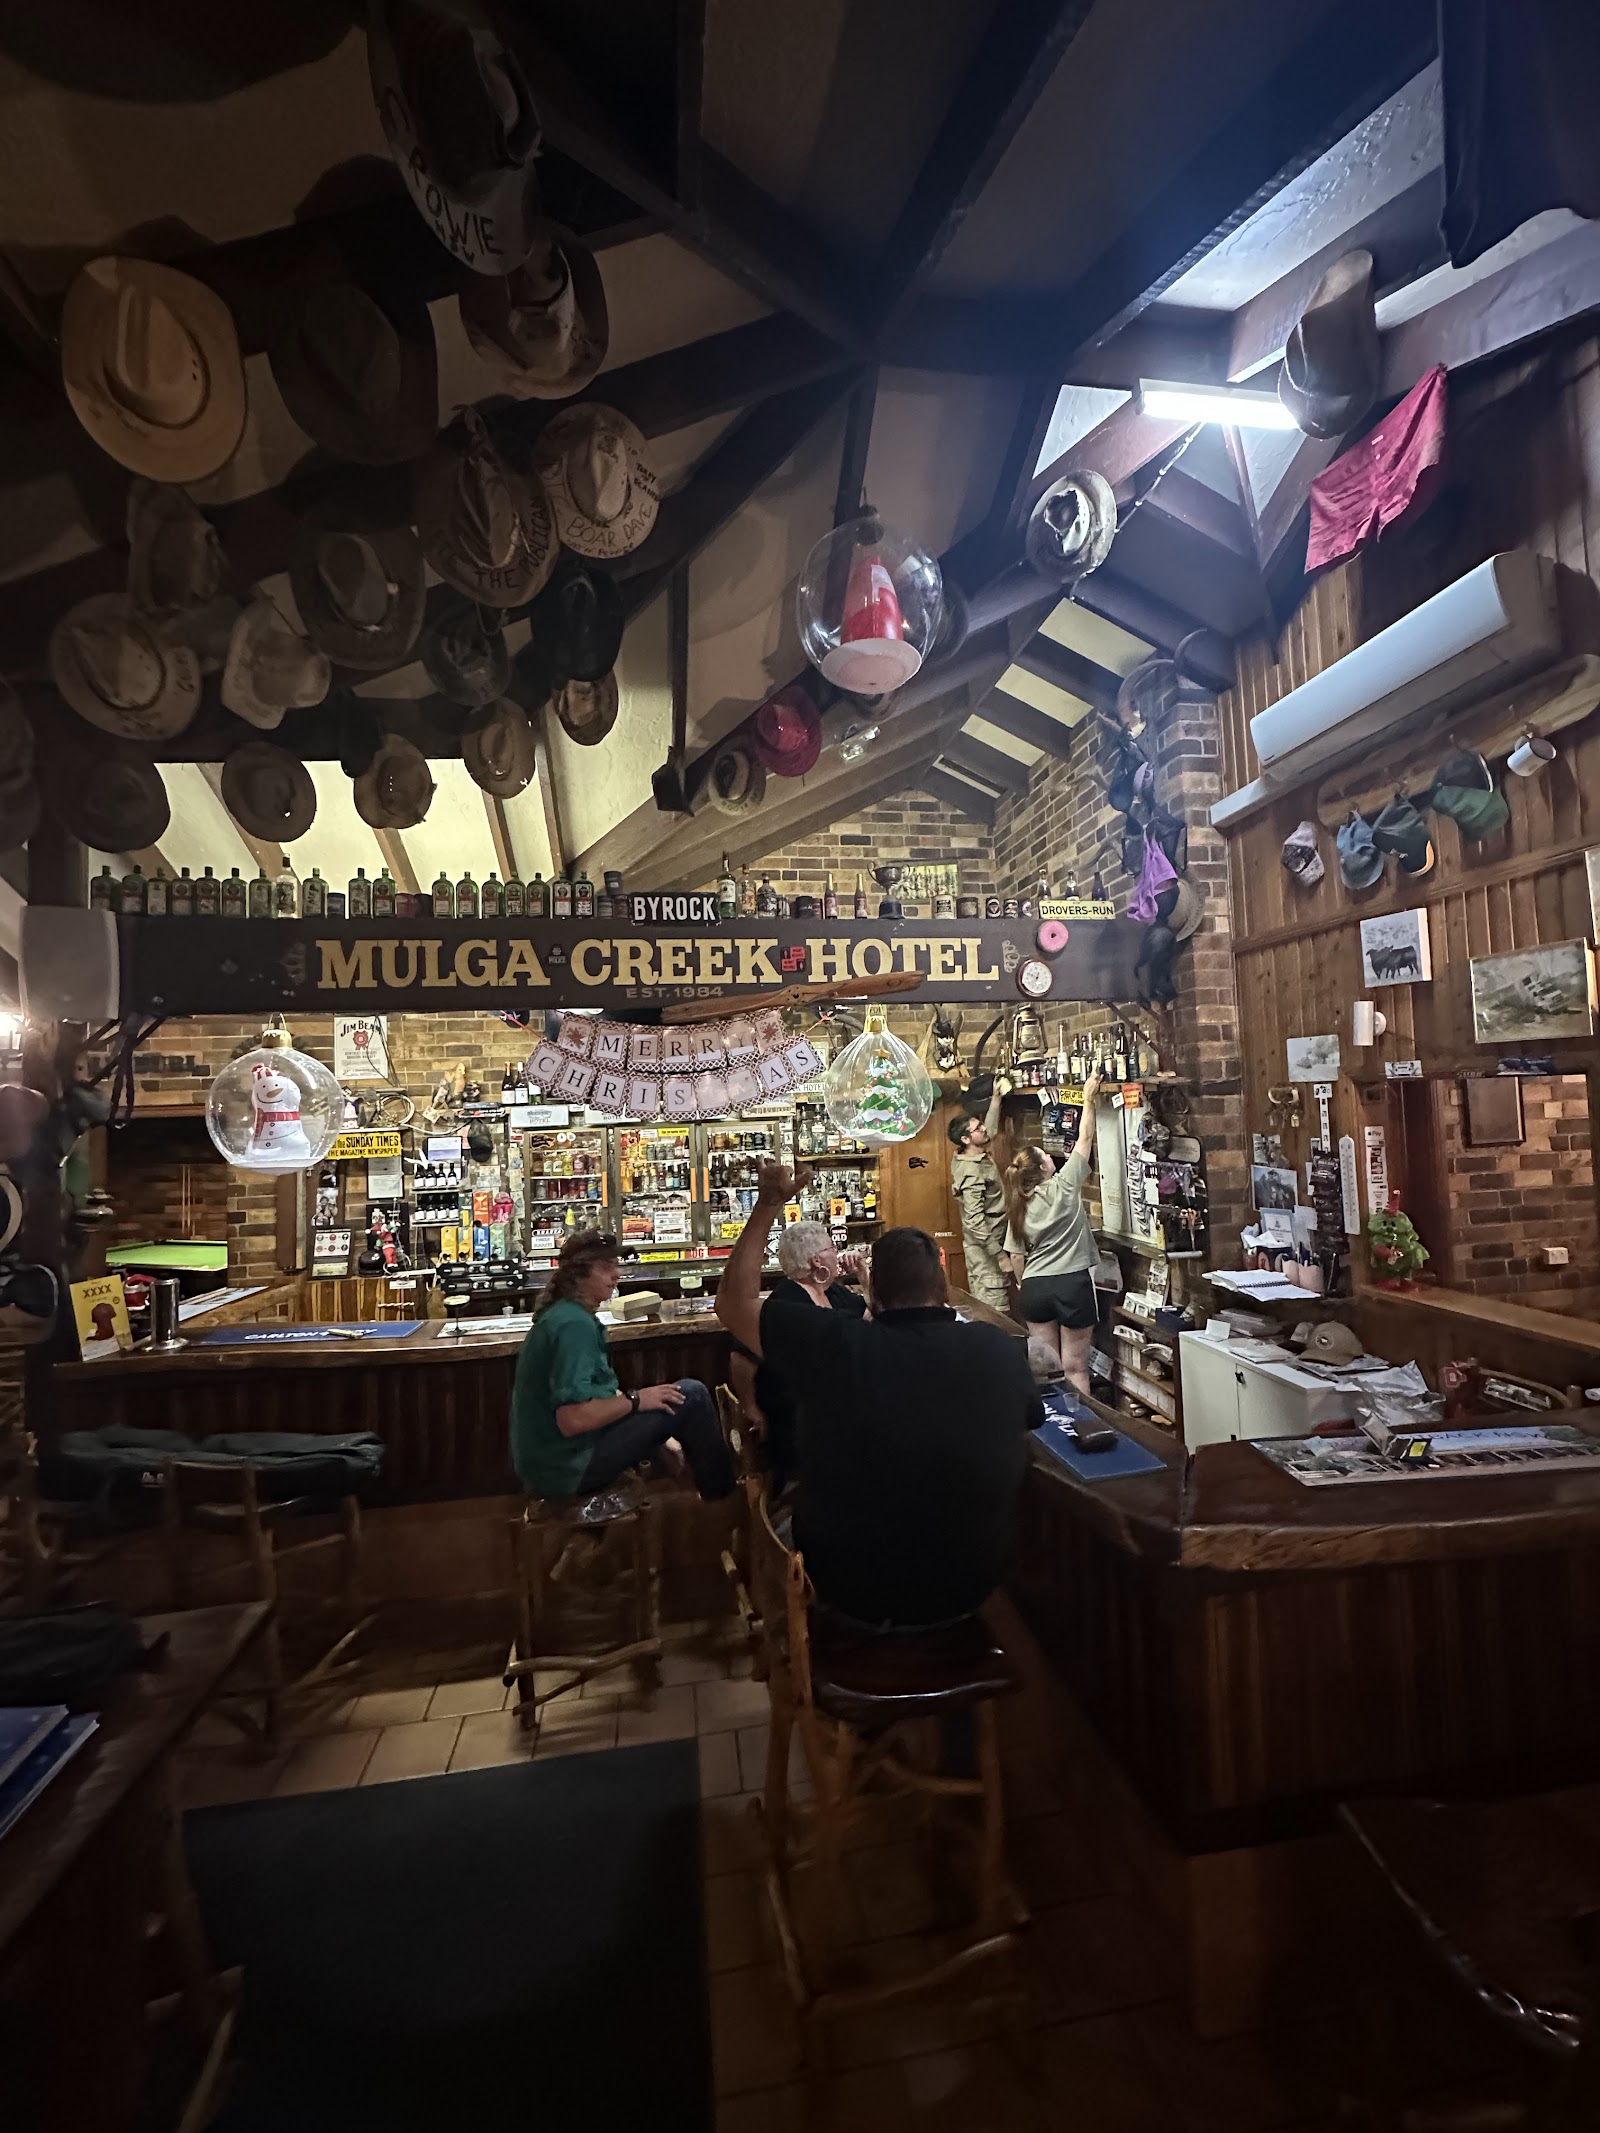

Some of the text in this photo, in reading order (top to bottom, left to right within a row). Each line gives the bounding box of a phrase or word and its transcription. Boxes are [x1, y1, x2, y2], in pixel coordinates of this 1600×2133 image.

[565, 515, 617, 549] BOAR
[622, 502, 654, 541] DAVE
[473, 569, 521, 590] THE
[633, 896, 717, 922] BYROCK
[1041, 904, 1115, 917] DROVERS-RUN
[315, 938, 551, 989] MULGA
[570, 938, 783, 987] CREEK
[806, 937, 1000, 983] HOTEL
[340, 1020, 382, 1038] JIM BEAM
[599, 1033, 744, 1057] MERRY
[538, 1050, 810, 1105] CHRISAS
[346, 1136, 375, 1148] SUNDAY
[375, 1135, 400, 1147] TIMES
[340, 1148, 368, 1157] MAGAZINE
[831, 1233, 848, 1242] OLD
[82, 1284, 112, 1299] XXXX
[244, 1331, 319, 1340] CARLTON
